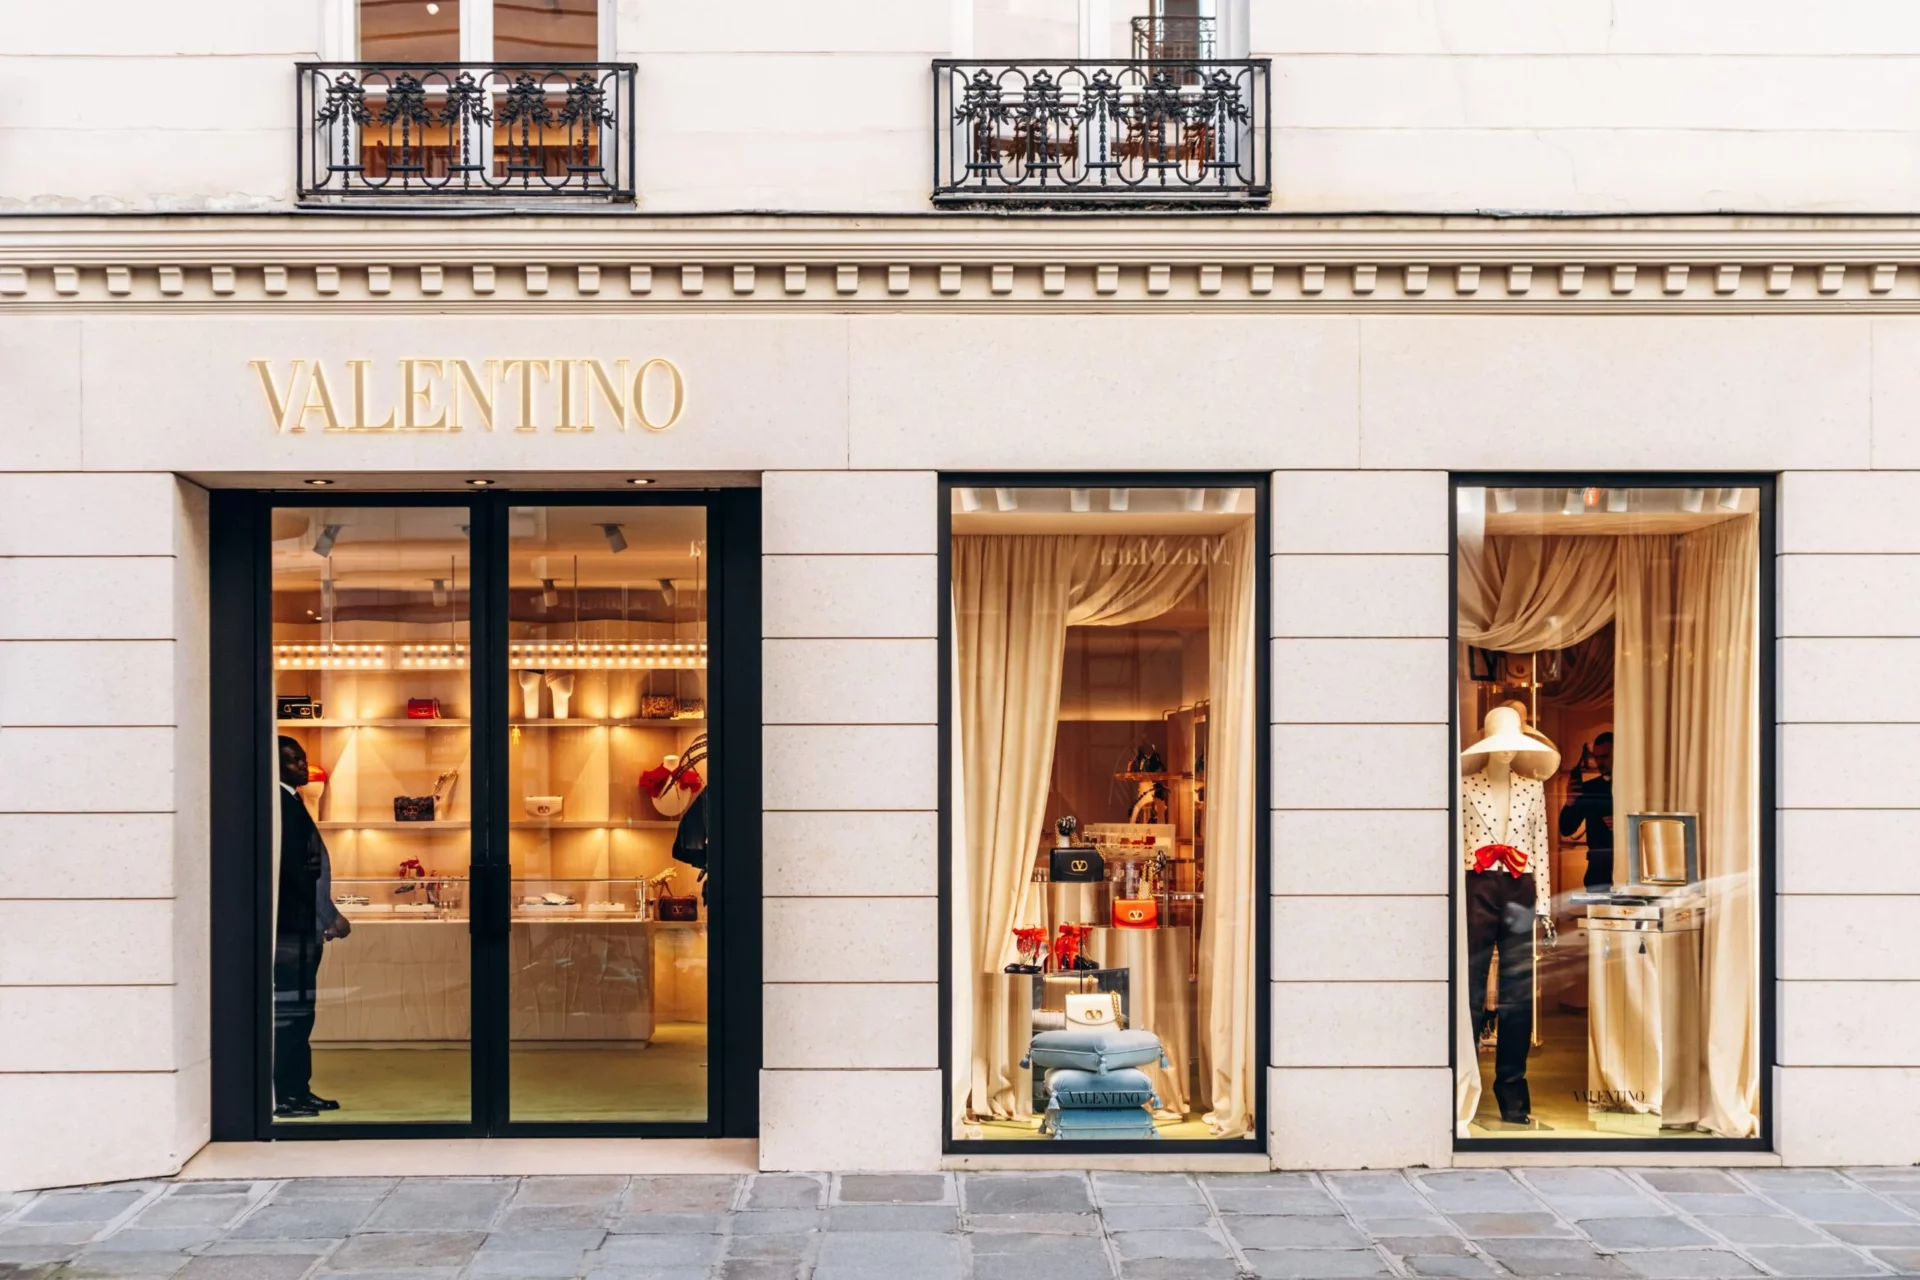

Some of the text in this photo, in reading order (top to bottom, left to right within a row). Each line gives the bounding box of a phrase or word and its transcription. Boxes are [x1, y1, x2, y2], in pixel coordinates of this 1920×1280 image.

[249, 357, 685, 432] VALENTINO
[1068, 1091, 1141, 1105] VALENTINO
[1572, 1090, 1645, 1103] VALENTINO
